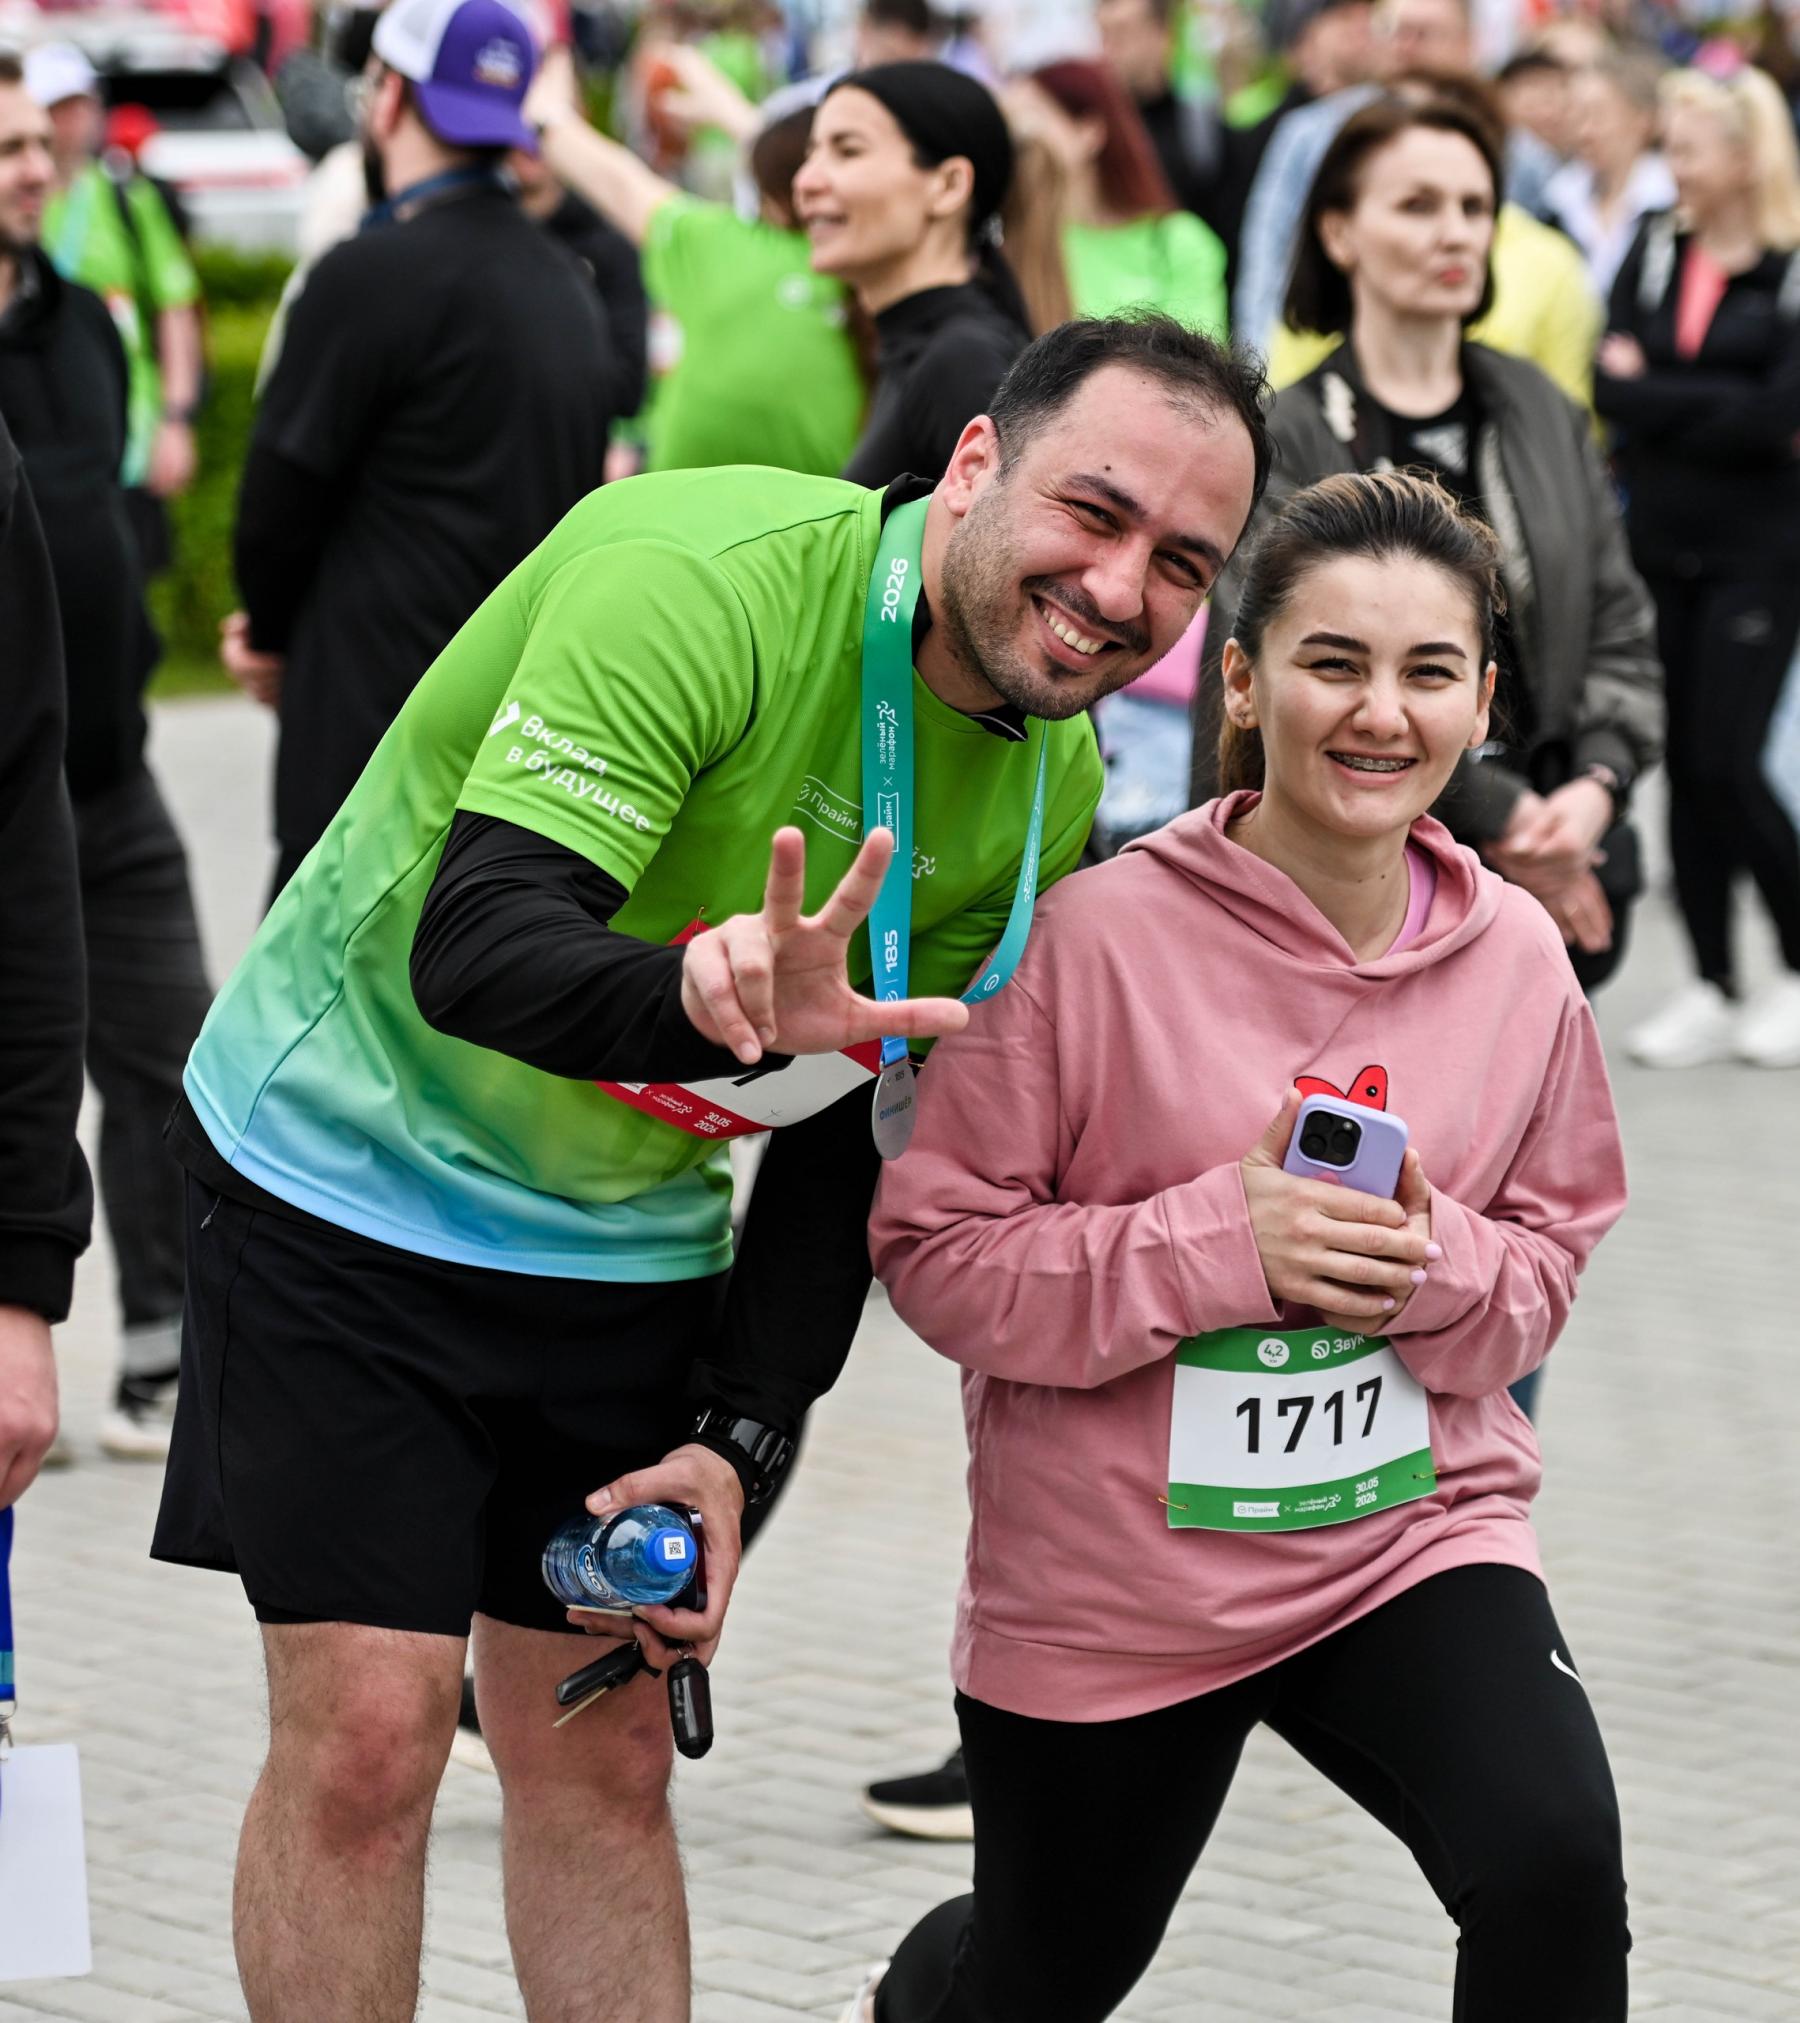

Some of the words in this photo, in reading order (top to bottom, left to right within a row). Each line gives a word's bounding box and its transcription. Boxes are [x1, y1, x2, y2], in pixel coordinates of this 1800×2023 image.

[880, 557, 909, 624] 2026
[520, 714, 609, 777] Вклад
[877, 721, 886, 764] зелёный
[887, 726, 896, 770] марафон
[505, 745, 524, 763] в
[524, 749, 650, 831] будущее
[810, 791, 859, 831] Прайм
[884, 801, 894, 830] райм
[884, 929, 899, 973] 185
[693, 1120, 719, 1134] 2026
[704, 1111, 732, 1128] 30.05
[1264, 1344, 1283, 1357] 4,2
[1333, 1333, 1366, 1354] Звук
[1236, 1375, 1383, 1454] 1717
[1354, 1492, 1378, 1509] 2026
[1355, 1476, 1379, 1495] 30.05
